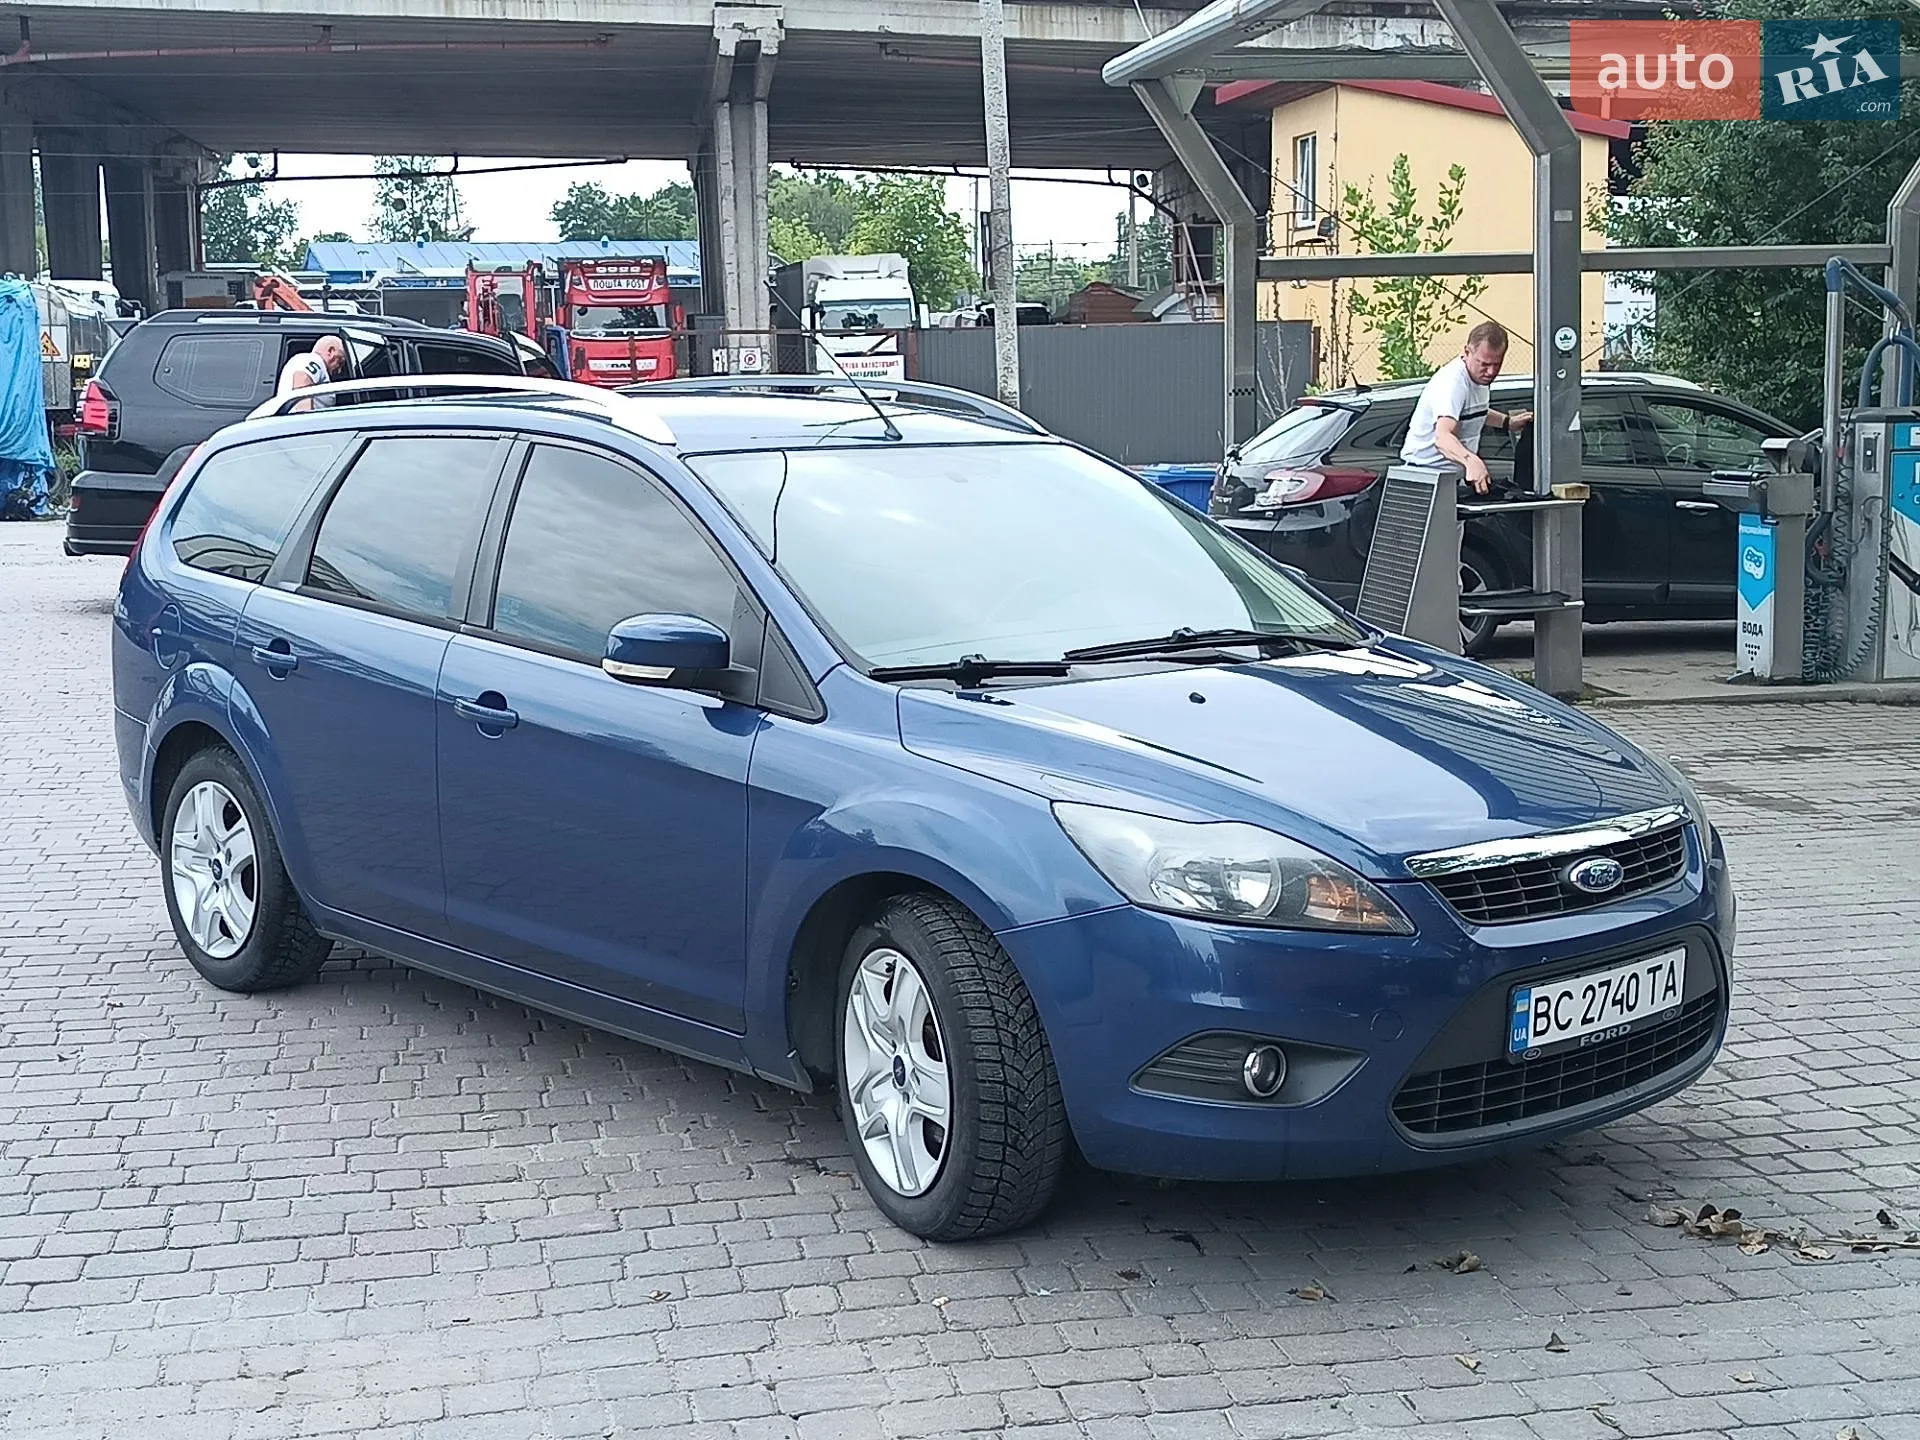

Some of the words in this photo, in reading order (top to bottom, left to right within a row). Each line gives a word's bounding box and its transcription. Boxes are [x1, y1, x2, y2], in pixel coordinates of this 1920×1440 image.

[626, 279, 645, 289] POST
[1742, 621, 1763, 637] ВОДА
[1590, 865, 1618, 885] Ford
[1533, 990, 1574, 1038] BC
[1580, 971, 1640, 1026] 2740
[1646, 960, 1678, 1006] TA
[1513, 1028, 1528, 1042] UA
[1579, 1023, 1632, 1048] FORD
